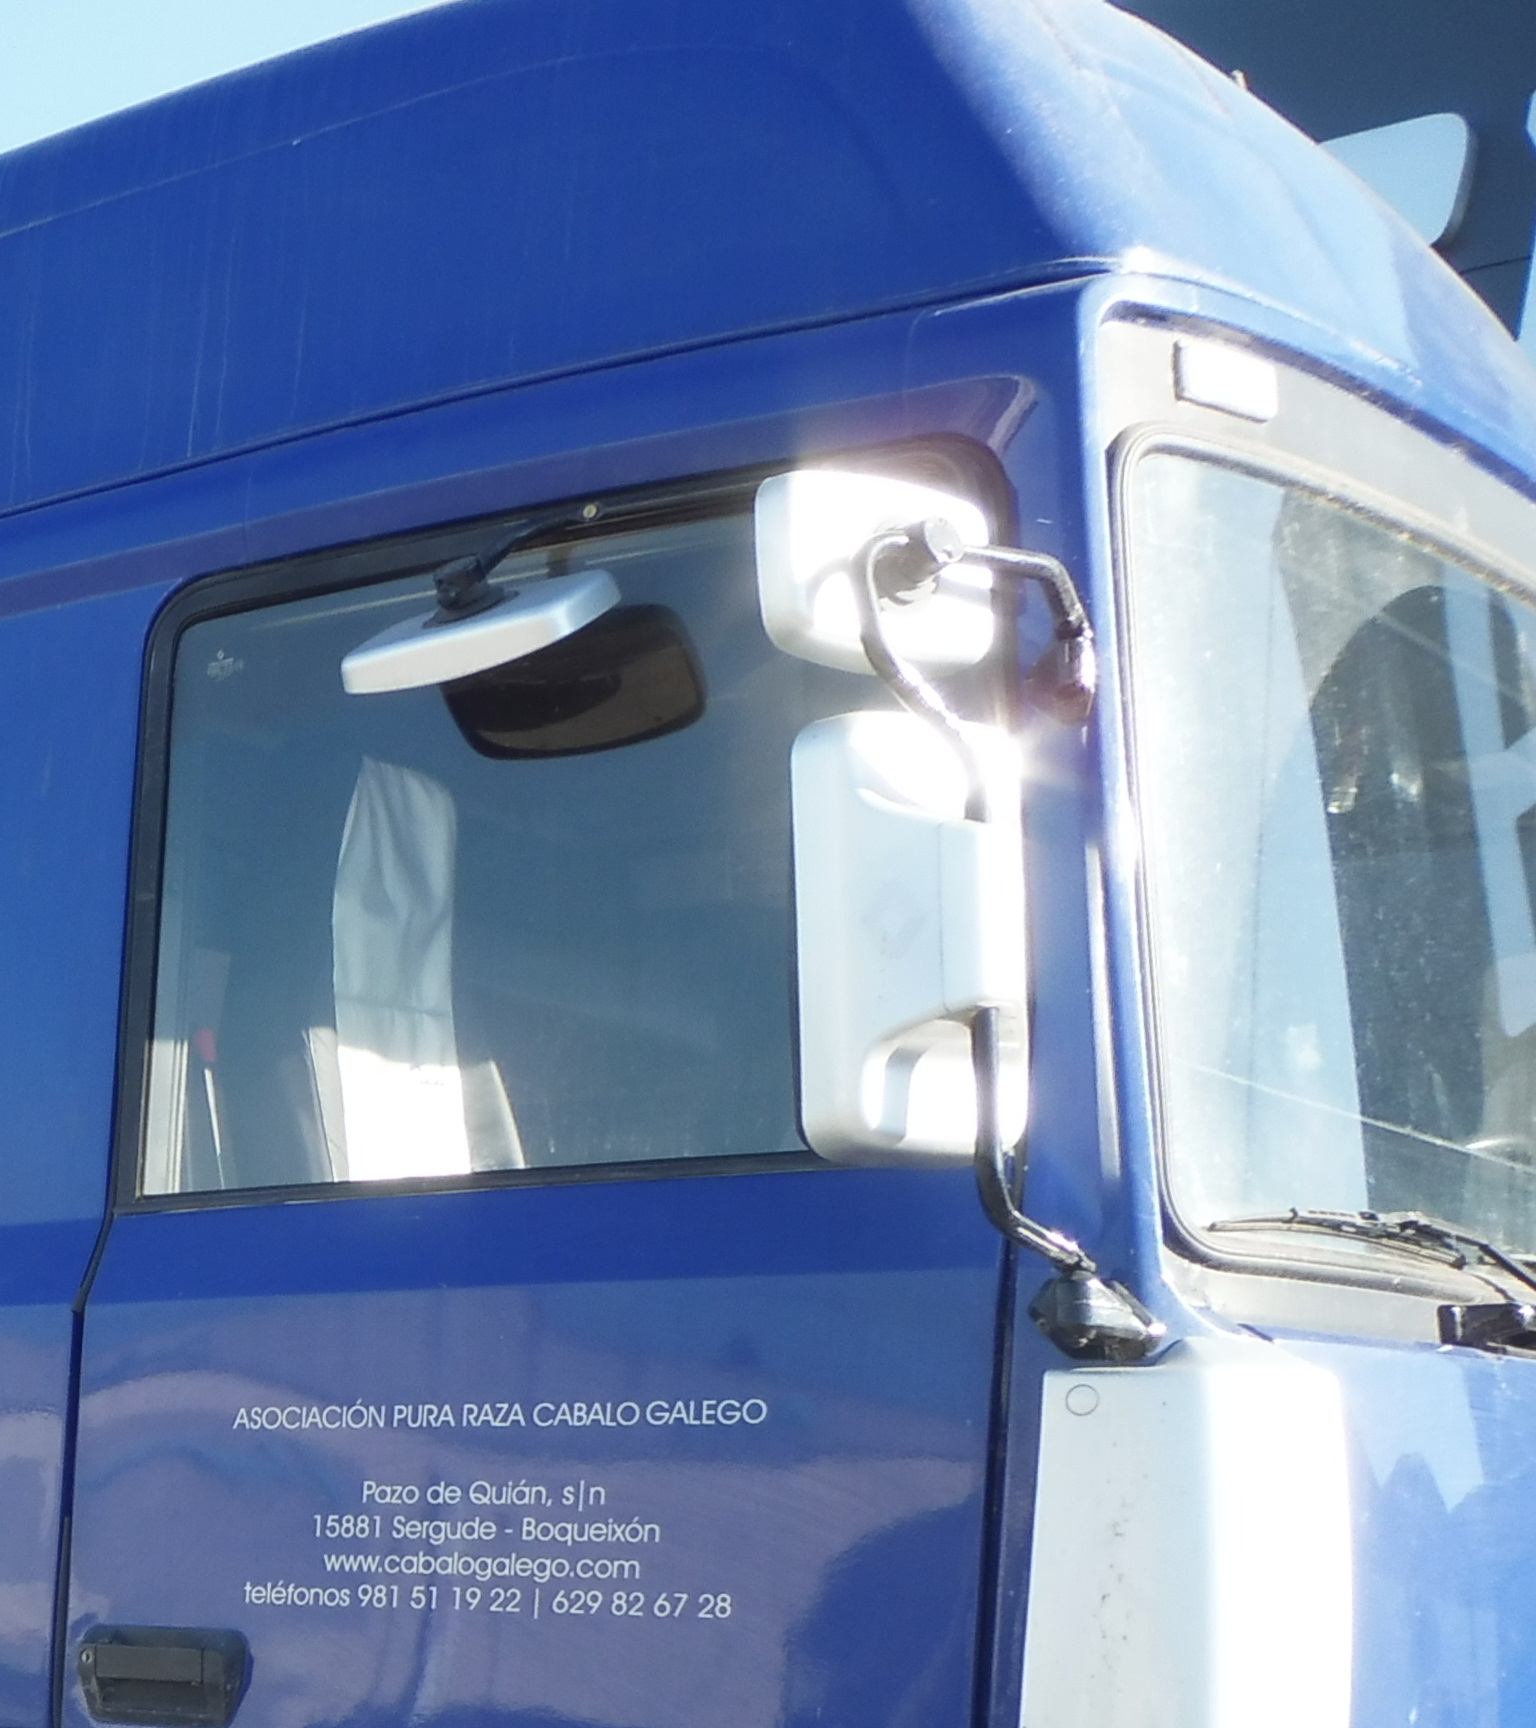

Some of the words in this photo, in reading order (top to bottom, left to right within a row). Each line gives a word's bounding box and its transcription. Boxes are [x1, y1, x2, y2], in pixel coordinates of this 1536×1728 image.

[232, 1398, 386, 1430] ASOCIACIÓN
[392, 1403, 456, 1428] PURA
[462, 1402, 526, 1427] RAZA
[532, 1401, 641, 1427] CABALO
[645, 1398, 769, 1426] GALEGO
[362, 1480, 420, 1505] Pazo
[426, 1480, 462, 1505] de
[469, 1478, 554, 1508] Quián,
[313, 1514, 381, 1539] 15881
[391, 1515, 497, 1546] Sergude
[521, 1516, 661, 1547] Boqueixón
[323, 1551, 641, 1583] www.cabalogalego.com
[243, 1579, 351, 1607] teléfonos
[357, 1584, 399, 1609] 981
[409, 1585, 437, 1610] 51
[452, 1586, 482, 1611] 19
[489, 1587, 522, 1613] 22
[552, 1589, 603, 1615] 629
[611, 1590, 645, 1617] 82
[653, 1592, 689, 1618] 67
[697, 1593, 732, 1619] 28
